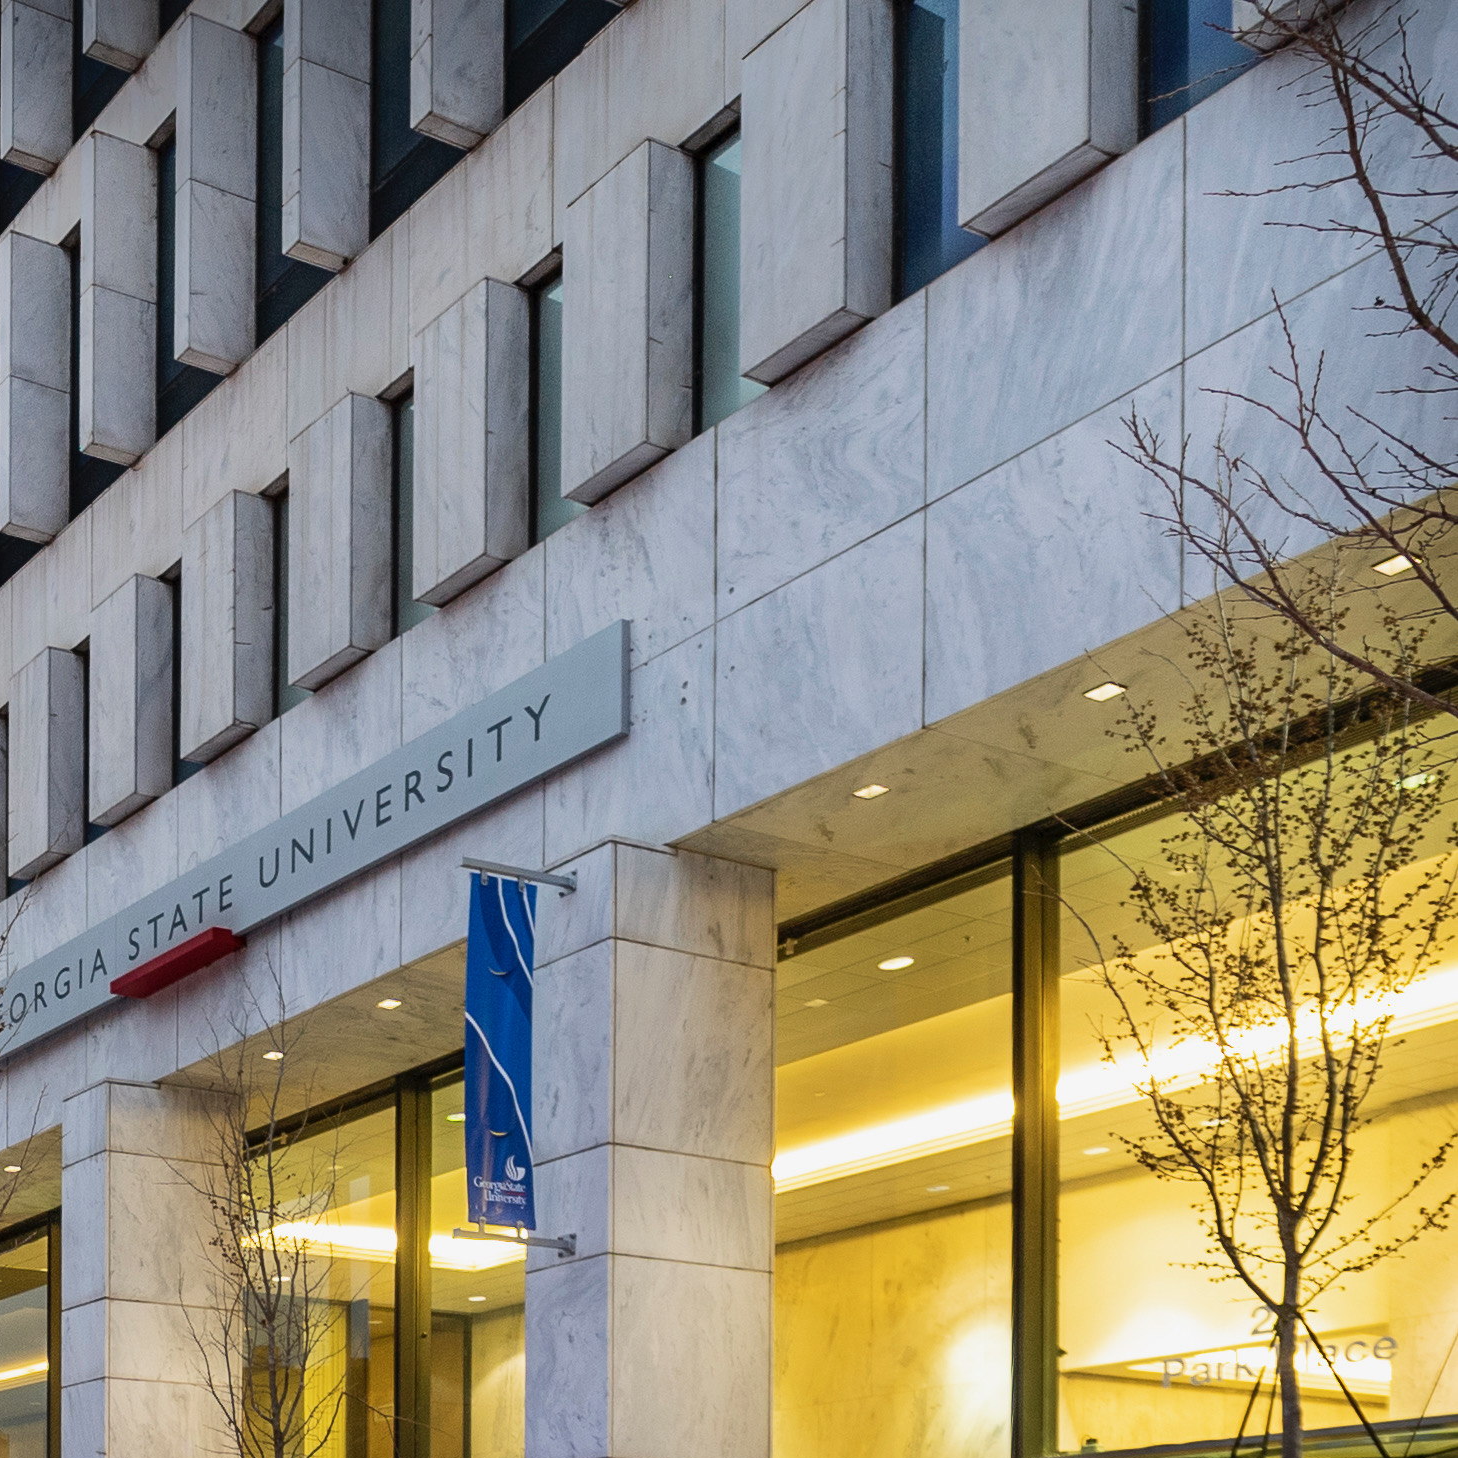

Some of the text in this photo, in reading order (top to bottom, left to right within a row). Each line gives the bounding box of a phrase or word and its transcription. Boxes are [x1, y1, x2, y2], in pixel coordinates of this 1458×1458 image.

[128, 874, 233, 961] STATE
[259, 693, 551, 888] UNIVERSITY
[1163, 1335, 1398, 1388] Park lace
